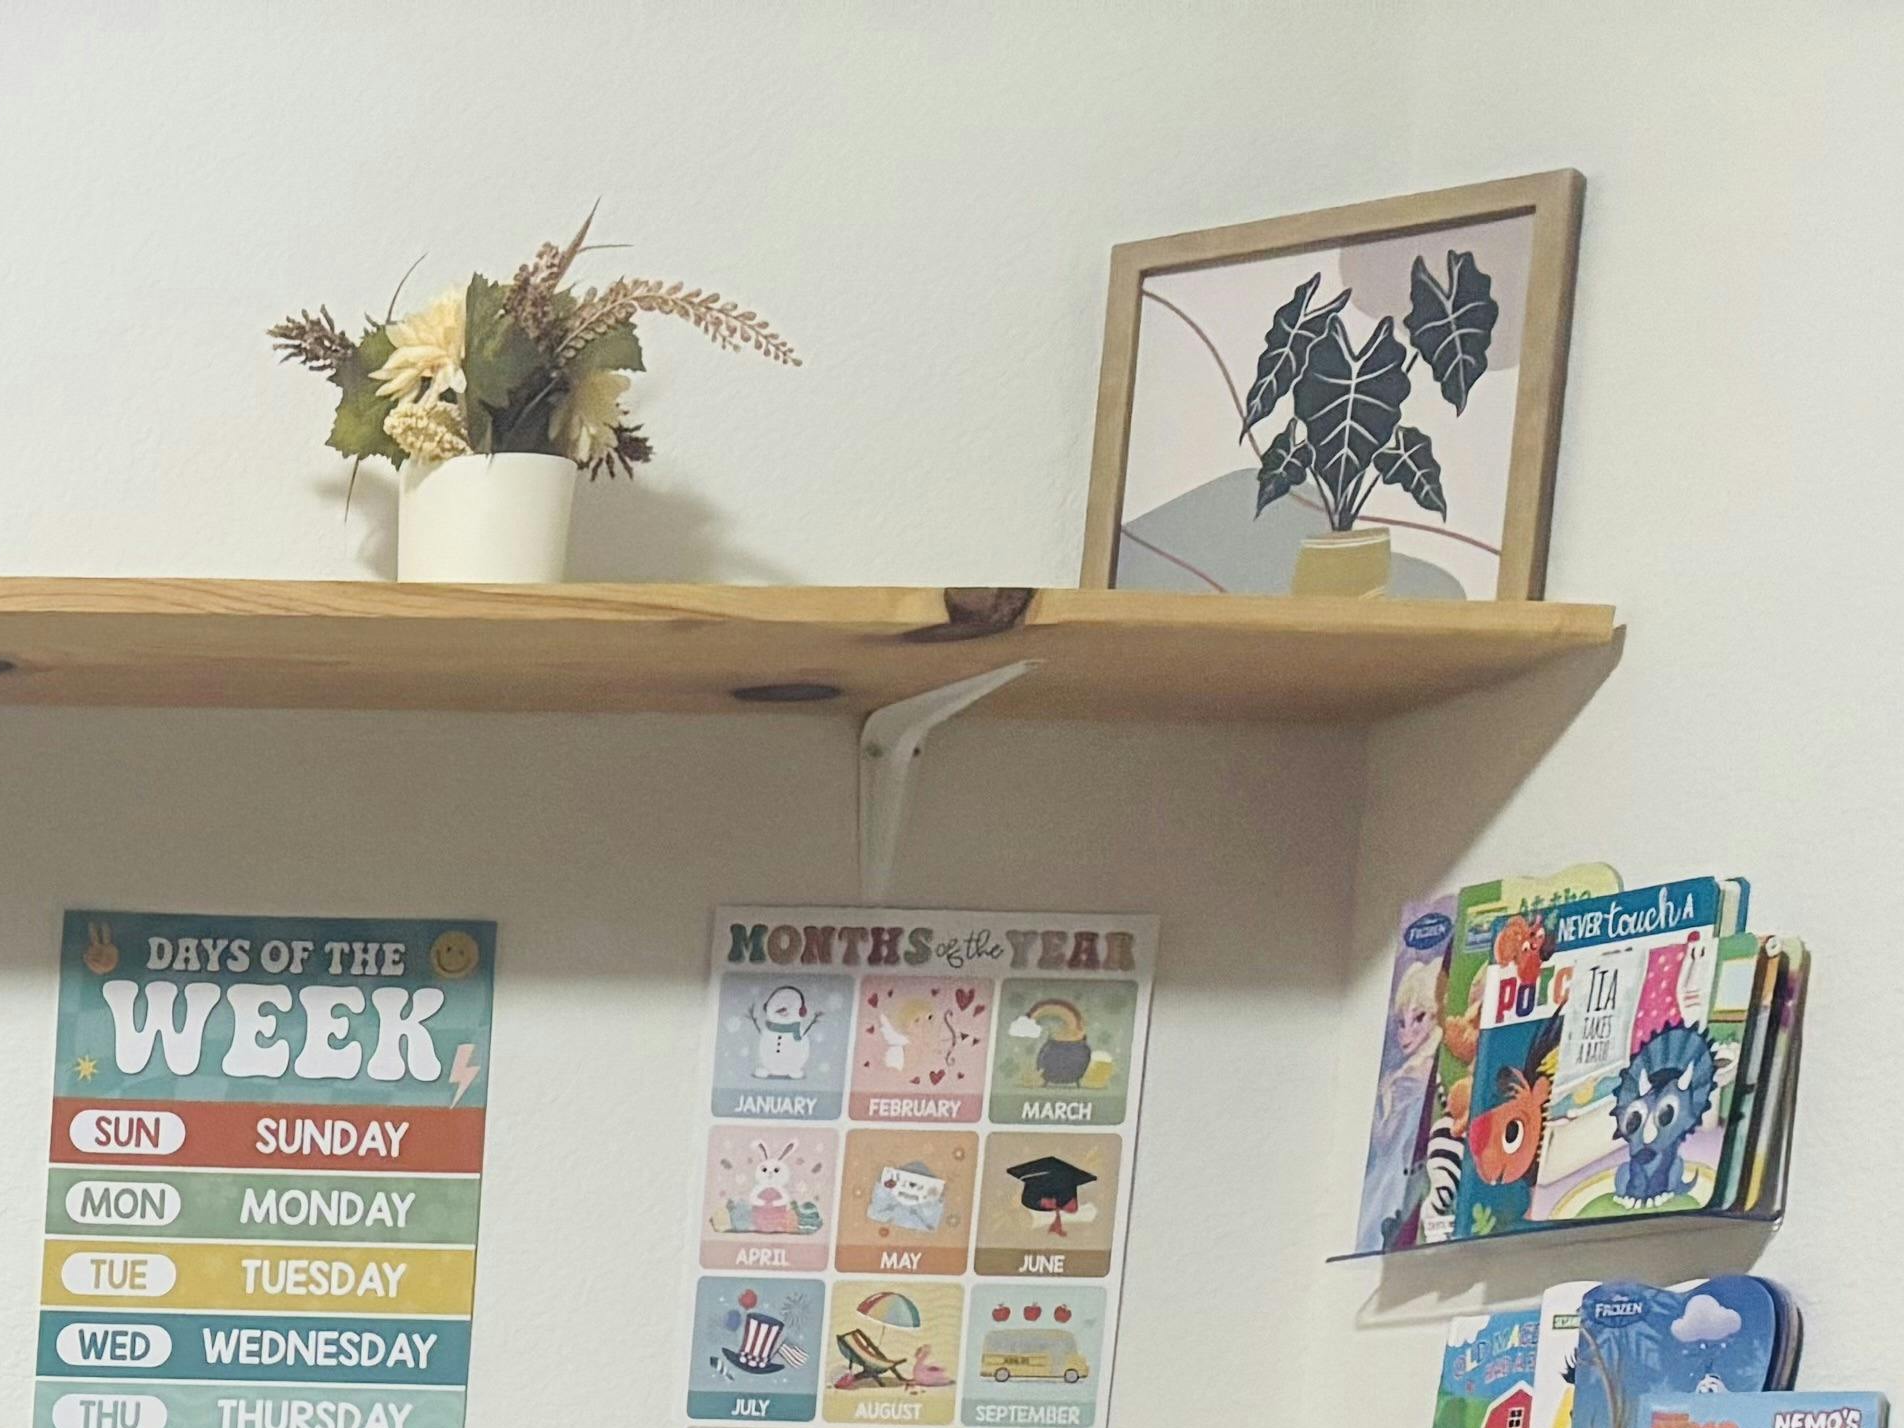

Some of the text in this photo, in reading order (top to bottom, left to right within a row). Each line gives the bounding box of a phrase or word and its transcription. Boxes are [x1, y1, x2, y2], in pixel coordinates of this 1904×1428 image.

[1558, 883, 1694, 940] NEVER touch A
[146, 937, 405, 976] DAYS OF THE
[727, 923, 1135, 970] MONTHS of the YEAR
[102, 979, 445, 1081] WEEK
[734, 1096, 817, 1114] JANUARY
[868, 1098, 962, 1118] FEBRUARY
[1022, 1101, 1091, 1121] MARCH
[94, 1116, 410, 1158] SUN SUNDAY
[80, 1188, 416, 1228] MON MONDAY
[90, 1258, 407, 1299] TUE TUESDAY
[1595, 1300, 1642, 1318] FROZEN
[78, 1328, 438, 1369] WED WEDNESDAY
[731, 1399, 770, 1416] JULY
